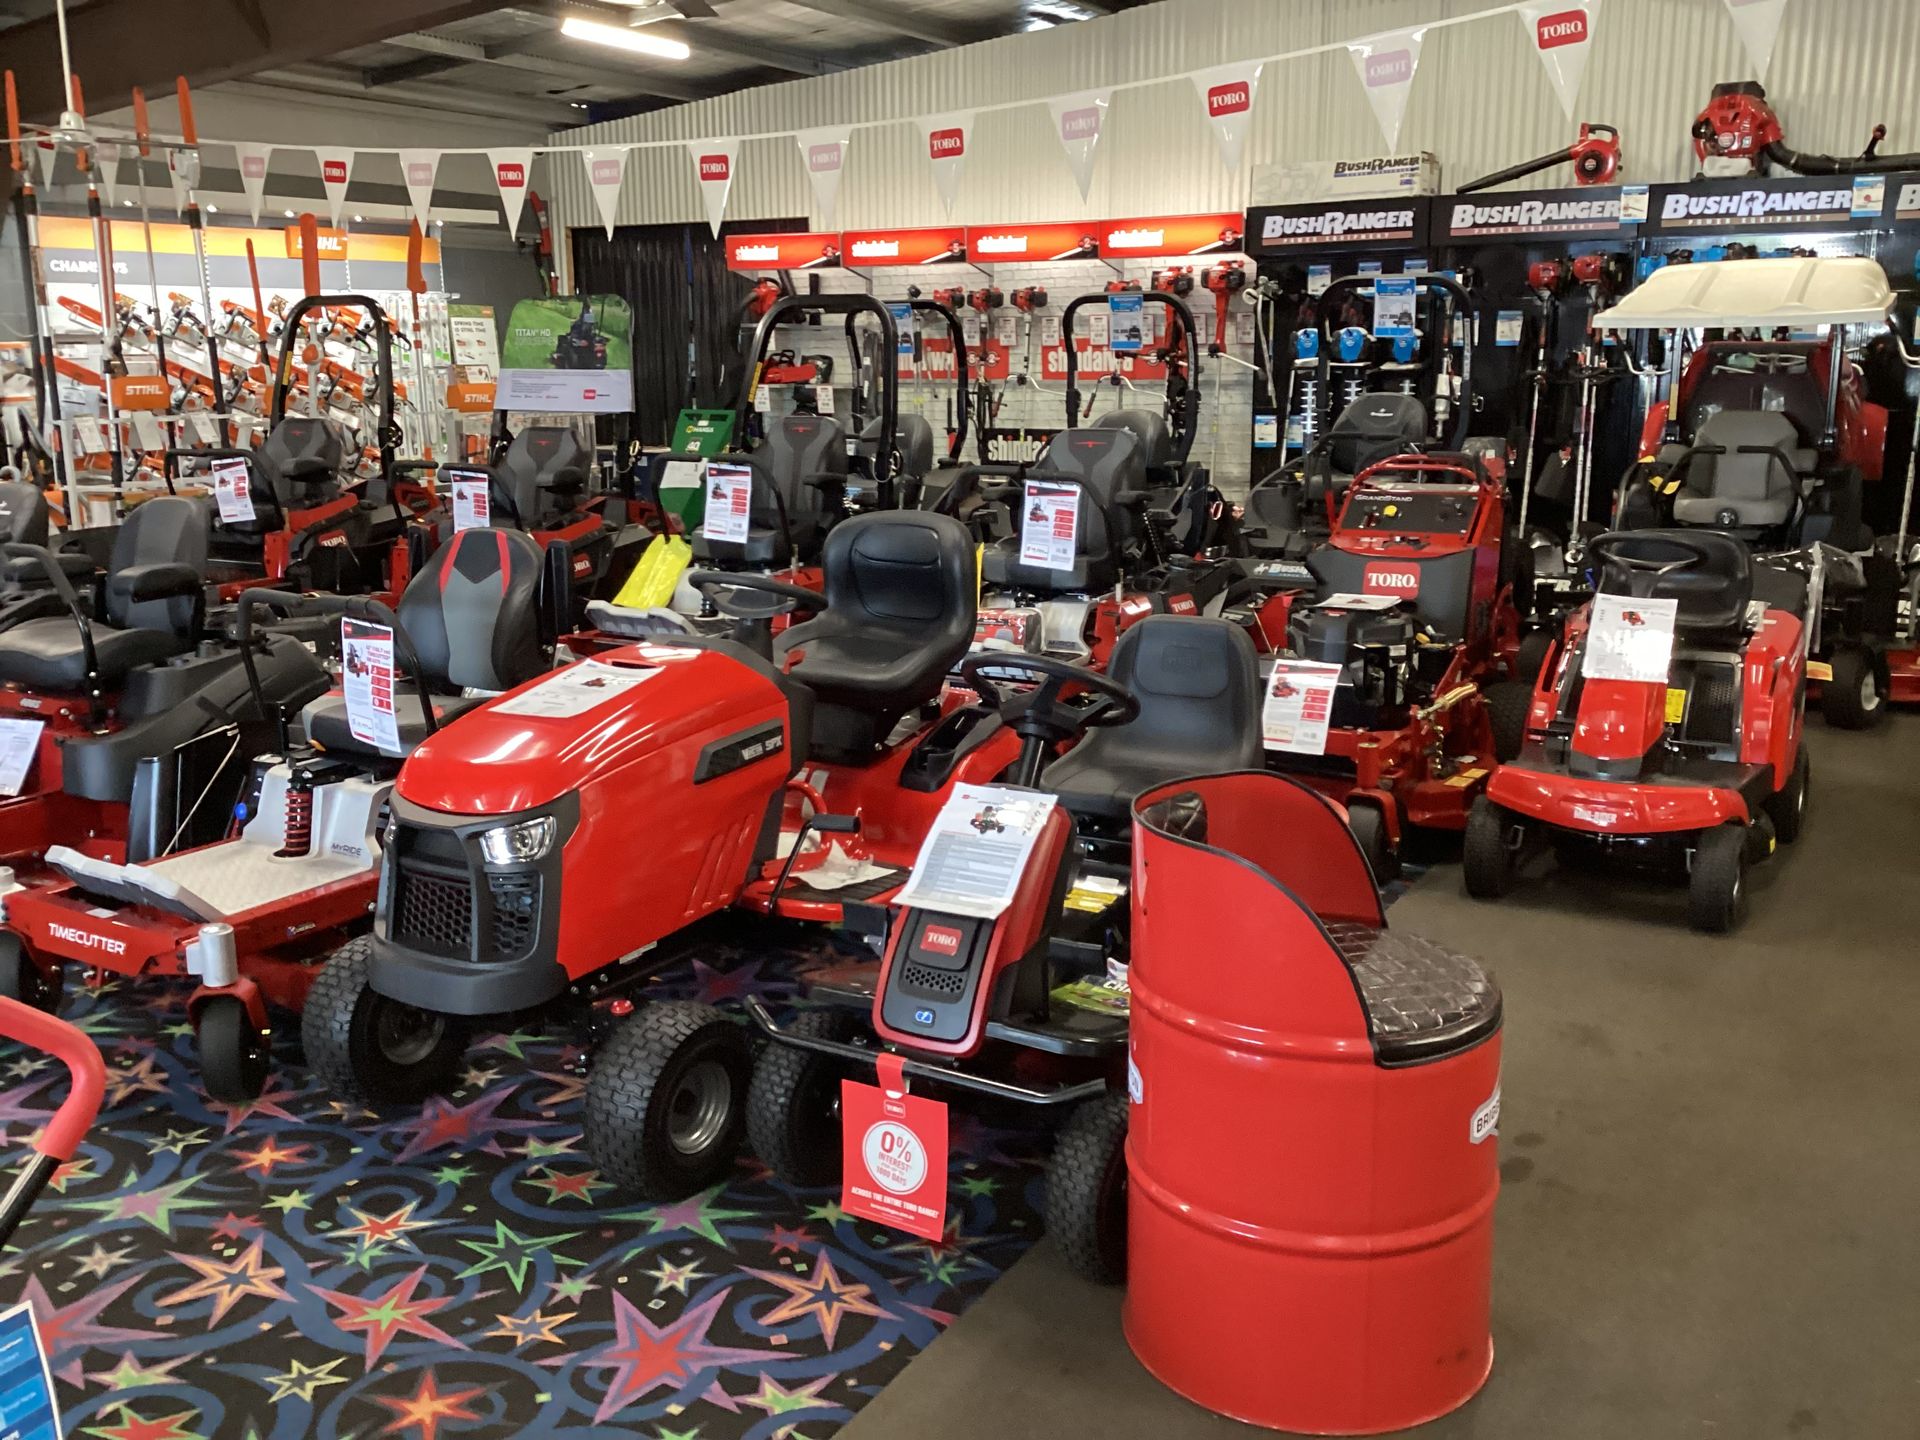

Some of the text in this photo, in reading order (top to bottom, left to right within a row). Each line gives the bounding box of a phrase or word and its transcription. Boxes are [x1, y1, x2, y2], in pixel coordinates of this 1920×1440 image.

[1540, 20, 1584, 40] TORO
[1210, 91, 1247, 108] TORO
[932, 137, 962, 151] TORO
[500, 170, 523, 181] TORO
[701, 162, 727, 173] TORO
[1661, 189, 1853, 220] BUSHRANGER
[1450, 200, 1621, 229] BUSHRANGER
[1262, 210, 1415, 239] BUSHRANGER
[125, 384, 164, 396] STIHL
[464, 393, 493, 403] STIHL
[1368, 572, 1418, 588] TORO
[48, 922, 126, 956] TIMECUTTER
[927, 932, 958, 947] TORO
[880, 1130, 912, 1164] 0%
